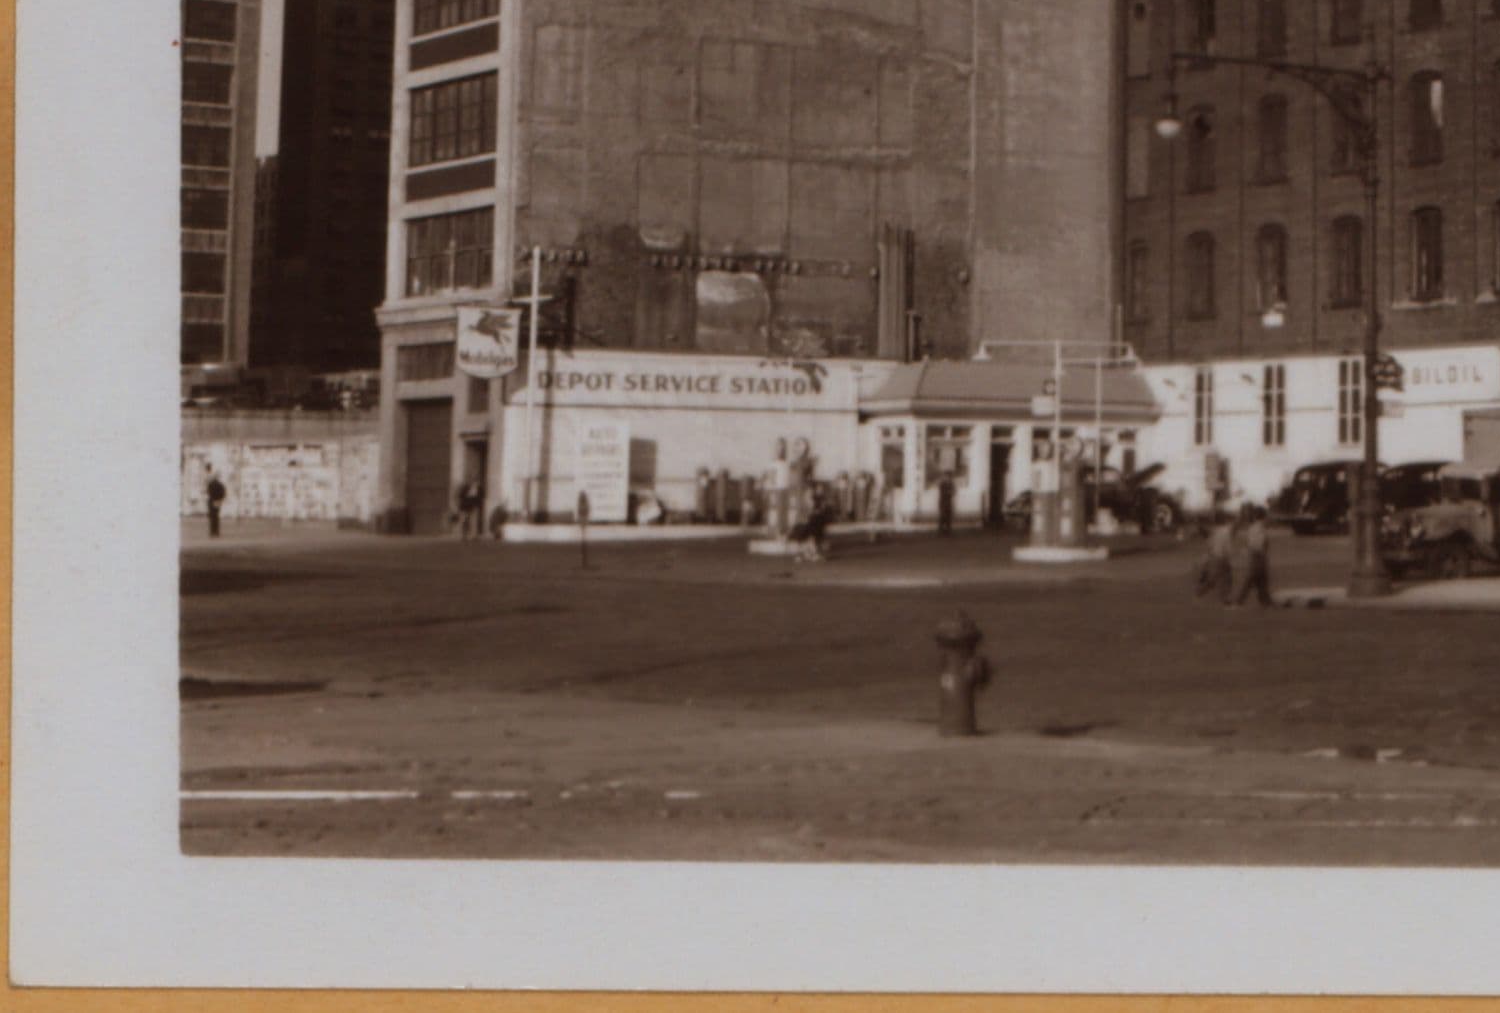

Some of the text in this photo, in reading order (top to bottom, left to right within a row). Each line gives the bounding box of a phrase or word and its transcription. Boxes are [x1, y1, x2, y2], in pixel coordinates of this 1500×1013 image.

[536, 371, 824, 397] DEPOT SERVICE STATION
